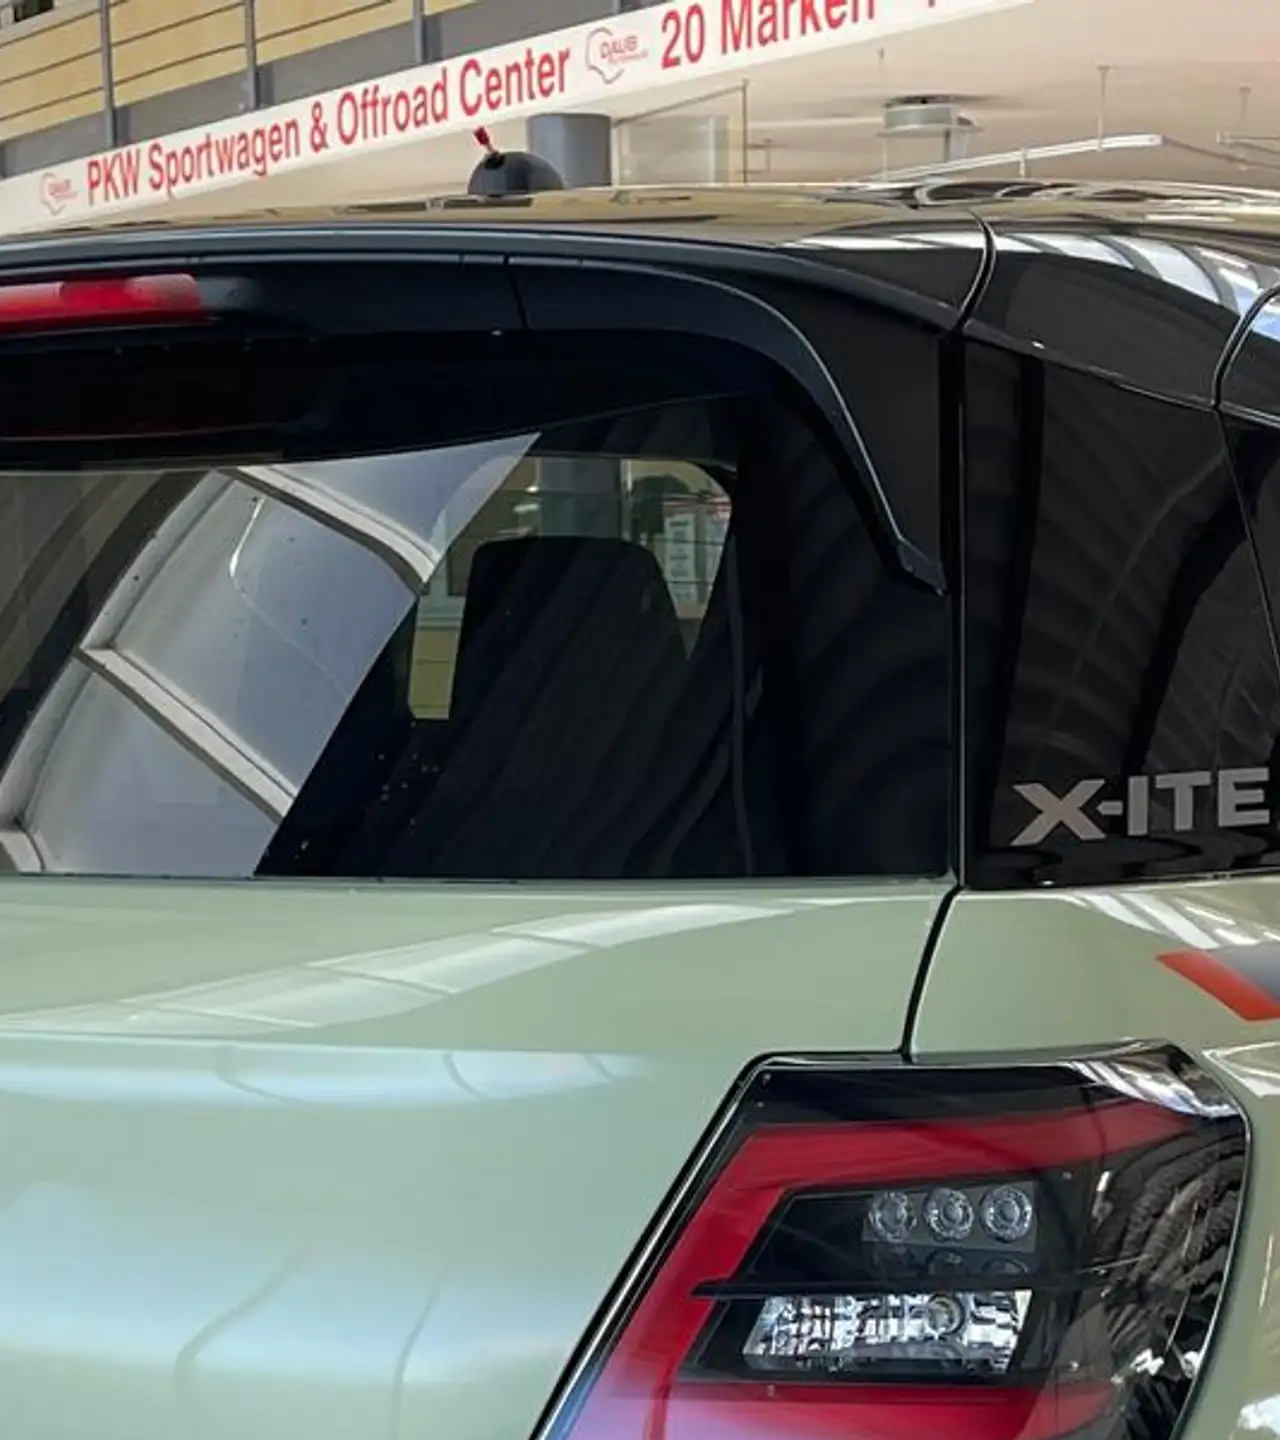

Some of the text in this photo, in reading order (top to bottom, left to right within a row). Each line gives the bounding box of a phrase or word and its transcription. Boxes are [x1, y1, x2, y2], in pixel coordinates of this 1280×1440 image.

[661, 3, 706, 69] 20
[86, 47, 570, 205] PKW Sportwagen & Offroad Center
[1010, 767, 1270, 846] X-ITE
